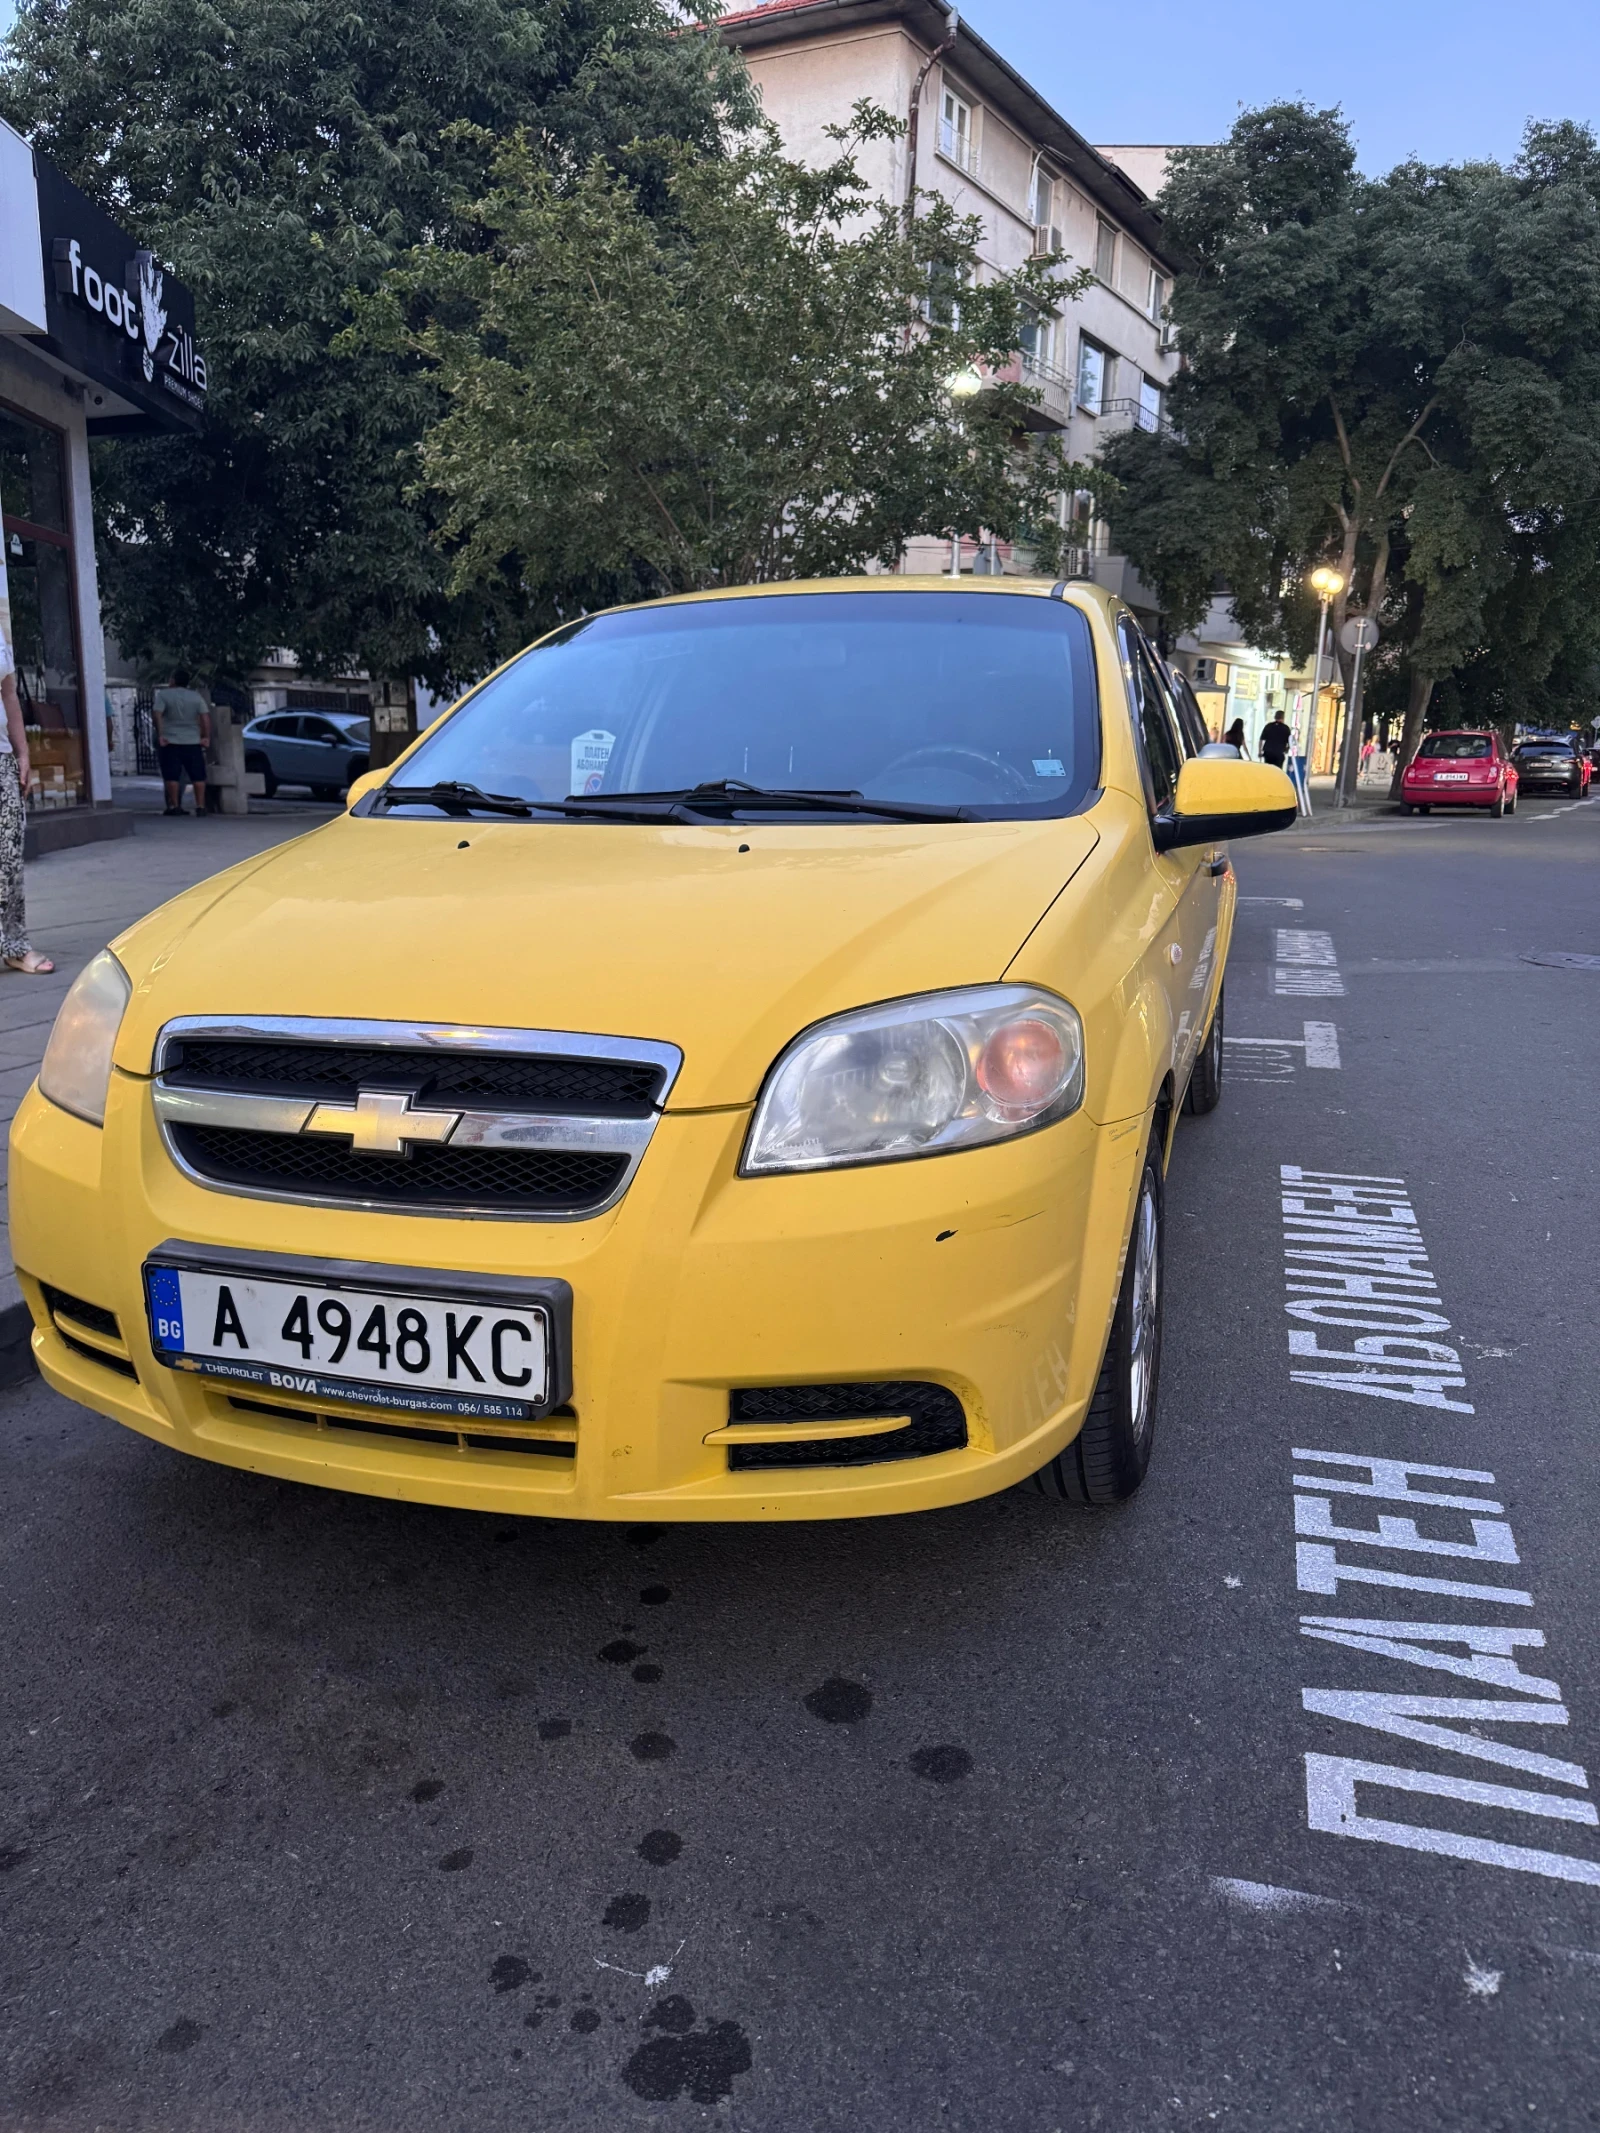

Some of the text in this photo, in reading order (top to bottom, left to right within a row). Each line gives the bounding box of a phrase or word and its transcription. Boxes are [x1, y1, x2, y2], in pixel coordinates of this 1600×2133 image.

[68, 239, 208, 391] foot zilla
[157, 1317, 182, 1339] BG
[212, 1285, 250, 1350] A
[205, 1362, 265, 1382] CHEVROLET
[269, 1371, 318, 1395] BOVA
[322, 1386, 453, 1412] www.chevrolet-burgas.com
[483, 1404, 502, 1416] 585
[504, 1406, 523, 1418] 114
[1280, 1164, 1600, 1887] ПЛАТЕН АБОНАМЕНТ
